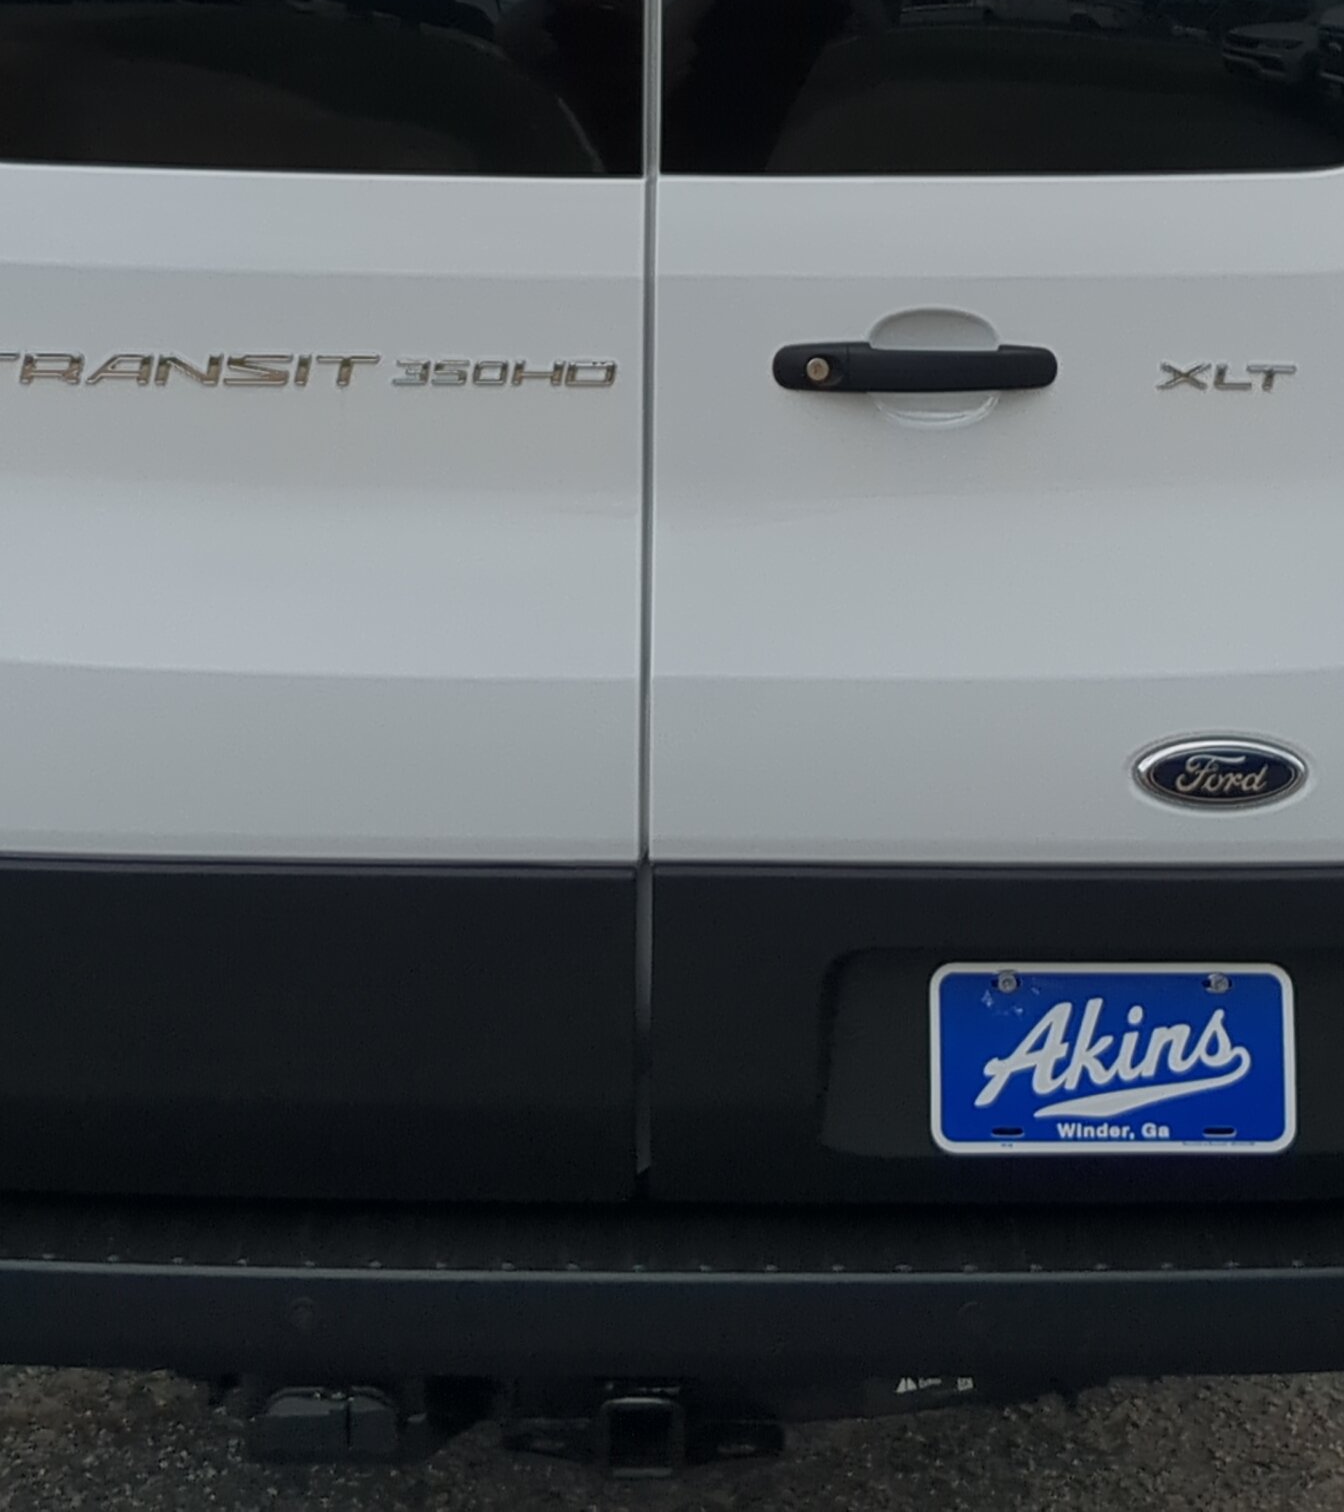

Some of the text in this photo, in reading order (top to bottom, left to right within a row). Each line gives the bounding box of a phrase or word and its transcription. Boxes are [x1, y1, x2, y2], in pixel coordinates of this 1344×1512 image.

[392, 359, 617, 387] 350HD
[1156, 363, 1297, 391] XLT
[1175, 754, 1269, 792] Ford
[974, 998, 1251, 1117] Akins
[1056, 1122, 1170, 1140] Winder, Ga
